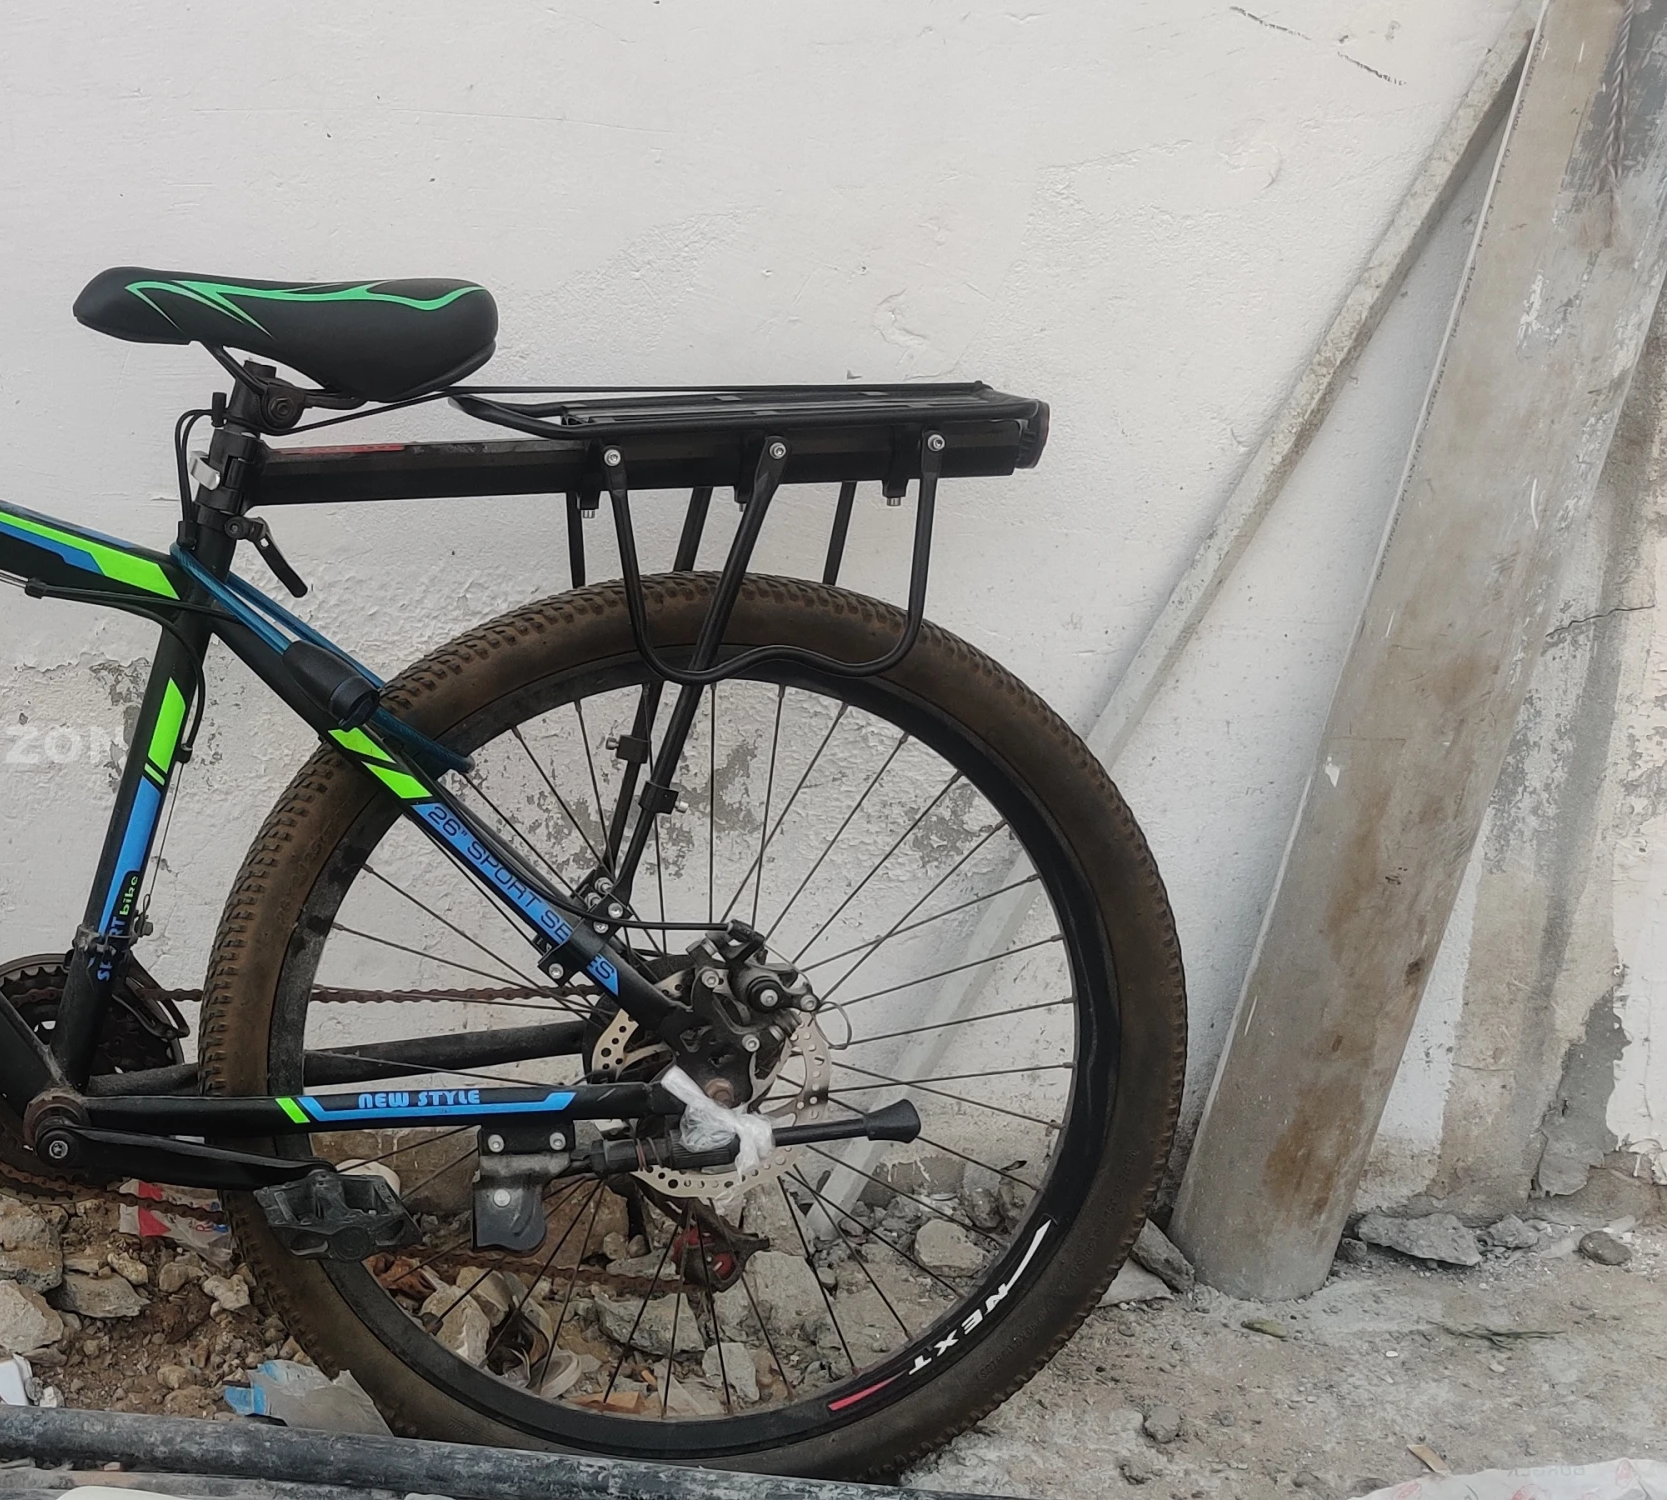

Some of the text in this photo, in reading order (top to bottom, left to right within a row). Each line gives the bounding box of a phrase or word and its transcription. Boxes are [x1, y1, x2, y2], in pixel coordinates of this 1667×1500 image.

[119, 876, 139, 916] bike
[466, 841, 545, 908] SPORT
[358, 1089, 481, 1109] NEW STYLE
[908, 1283, 1008, 1376] NEXT
